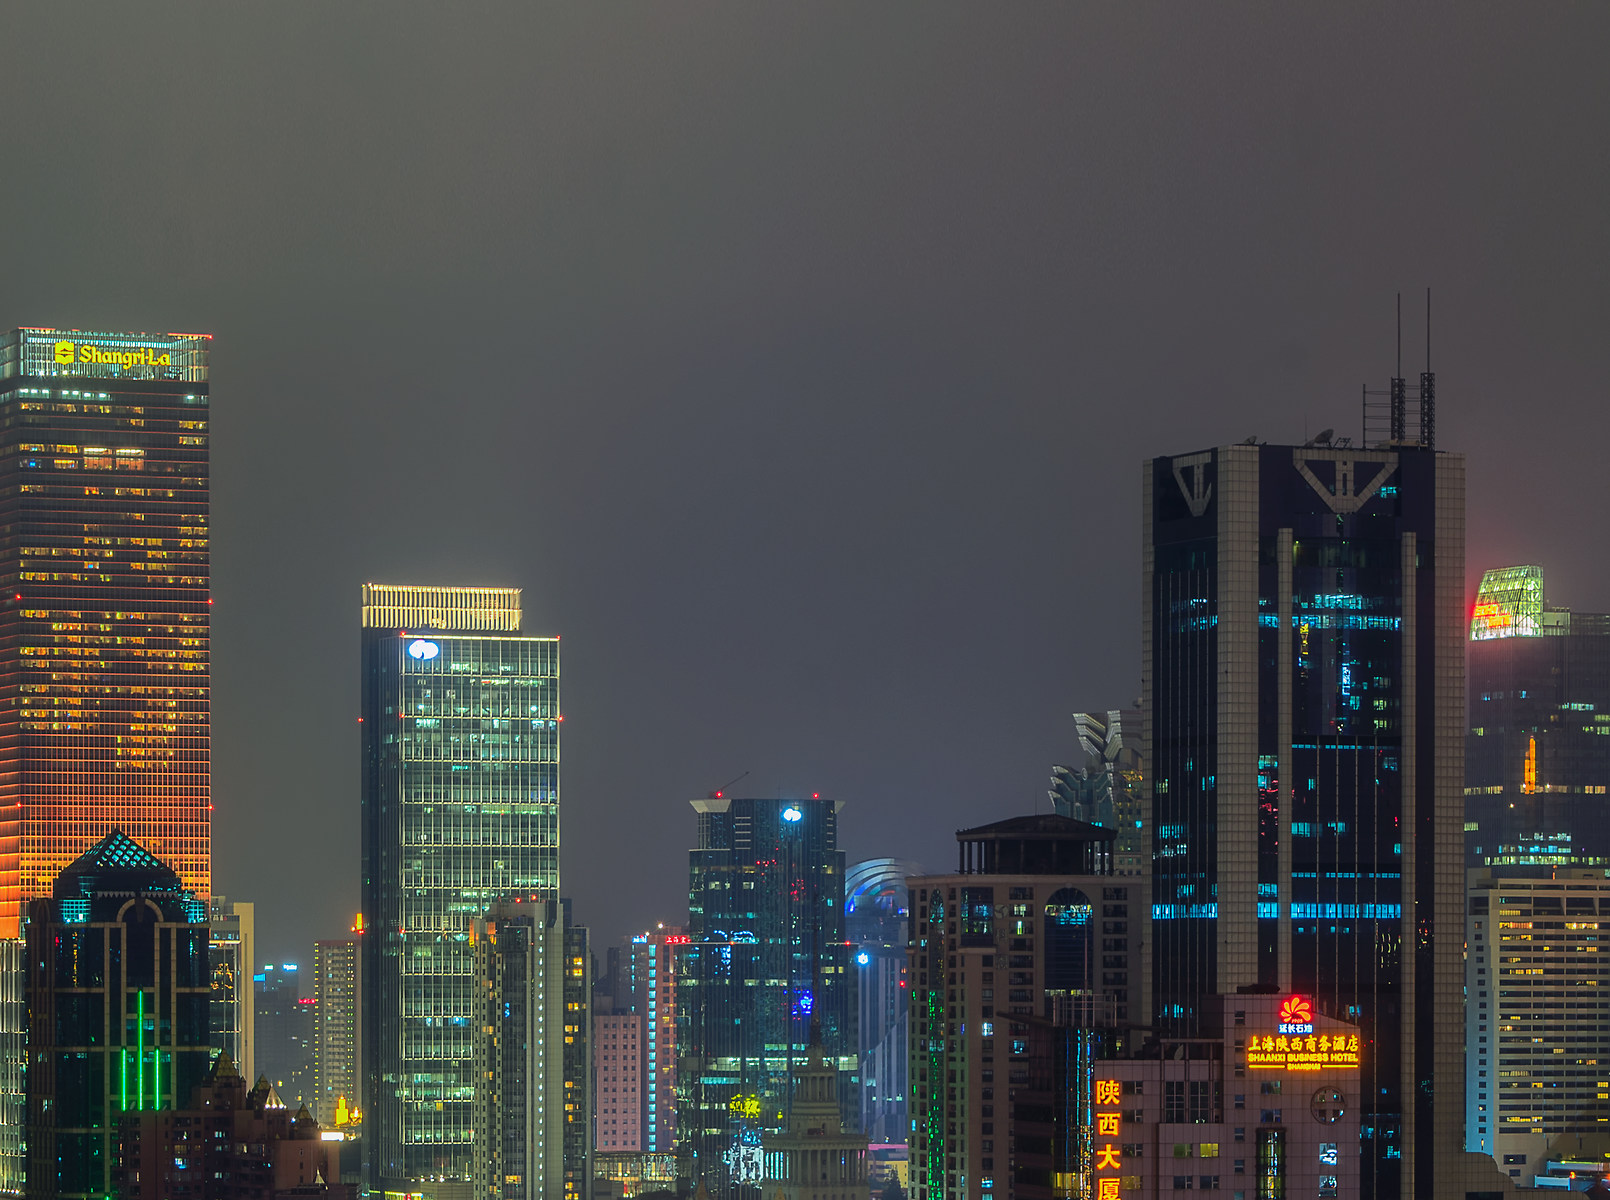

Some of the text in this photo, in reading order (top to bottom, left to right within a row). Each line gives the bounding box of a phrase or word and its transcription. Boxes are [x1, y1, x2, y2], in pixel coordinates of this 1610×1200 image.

[79, 345, 171, 370] Shangri-La
[1279, 1024, 1313, 1034] 延长石油
[1248, 1034, 1359, 1052] 上海陕西商务酒店
[1248, 1053, 1359, 1062] SHAANXI BUSINESS HOTEL
[1287, 1063, 1321, 1071] SHANGHAI
